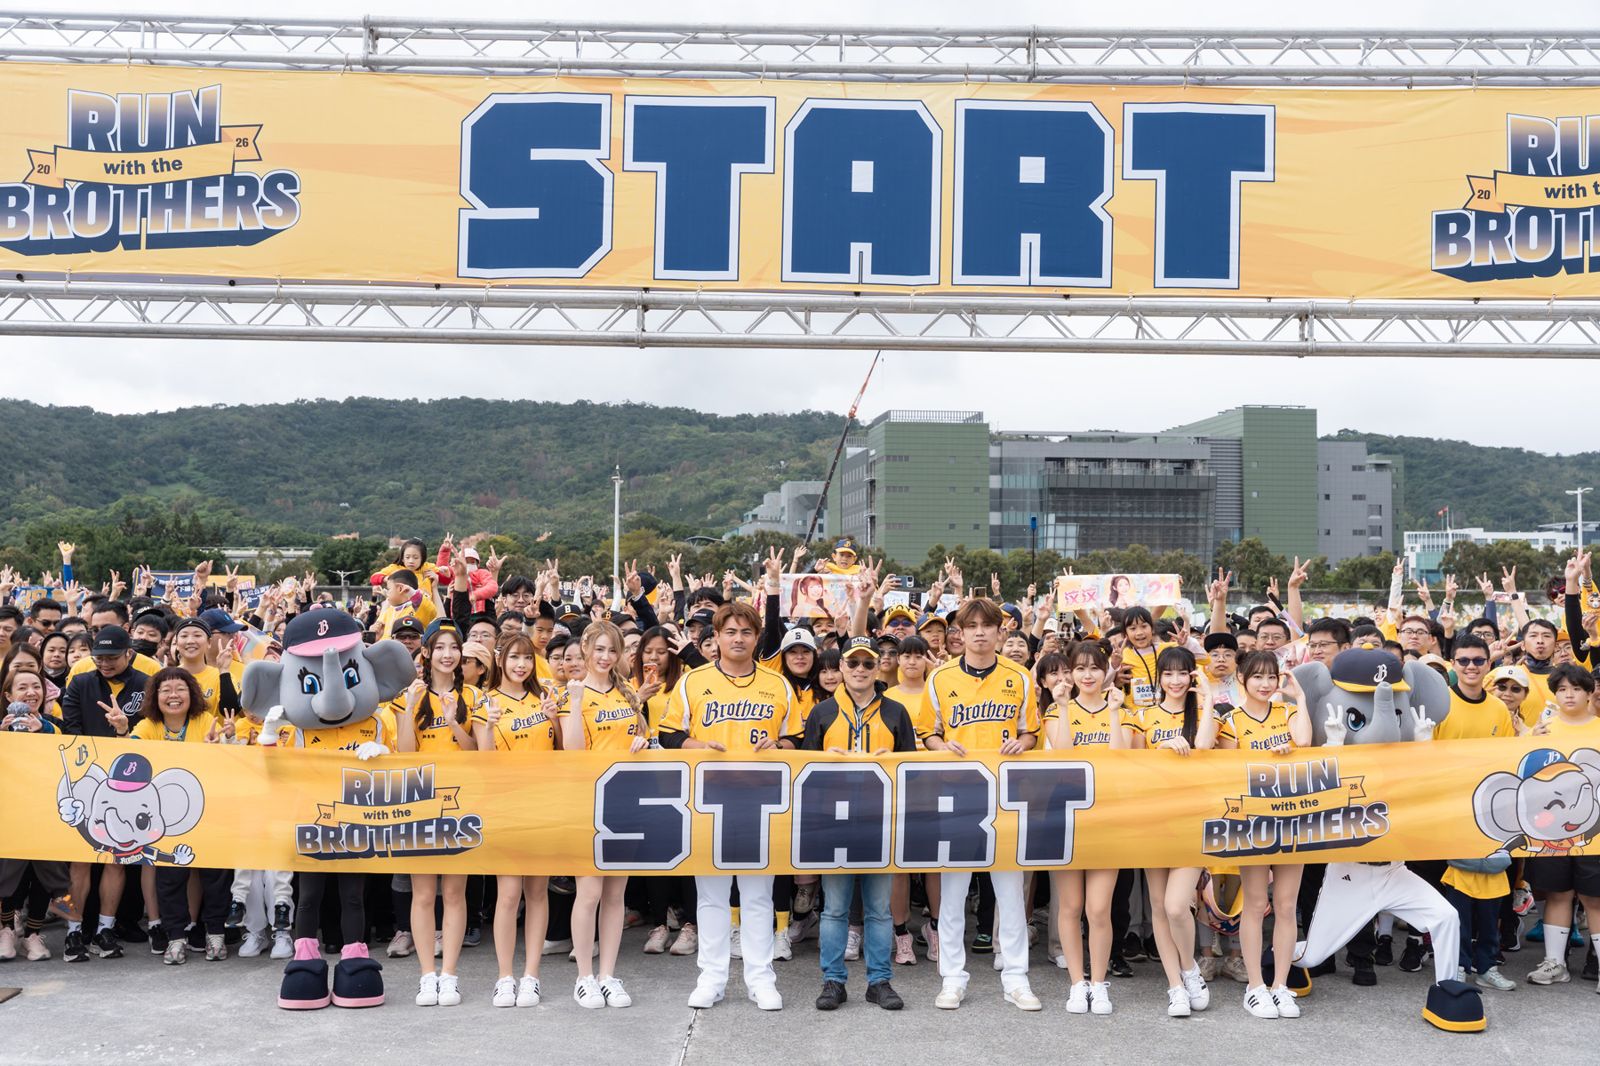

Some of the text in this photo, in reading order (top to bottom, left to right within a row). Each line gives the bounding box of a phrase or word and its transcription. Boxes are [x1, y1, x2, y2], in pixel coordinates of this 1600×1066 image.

[67, 83, 222, 152] RUN
[235, 136, 249, 149] 26
[36, 163, 51, 175] 20
[103, 156, 183, 176] with the
[457, 92, 1276, 290] START
[1477, 189, 1491, 200] 20
[1544, 183, 1587, 199] with
[0, 168, 301, 256] BROTHERS
[1431, 206, 1600, 283] BROT
[1149, 580, 1174, 602] 21
[402, 618, 413, 627] G
[702, 698, 775, 728] Brothers
[948, 699, 1018, 729] Brothers
[342, 763, 436, 806] RUN
[1247, 756, 1341, 797] RUN
[443, 794, 452, 802] 26
[1270, 799, 1319, 812] with the
[363, 808, 412, 820] with the
[594, 761, 1095, 870] START
[295, 814, 483, 861] BROTHERS
[1202, 802, 1391, 858] BROTHERS
